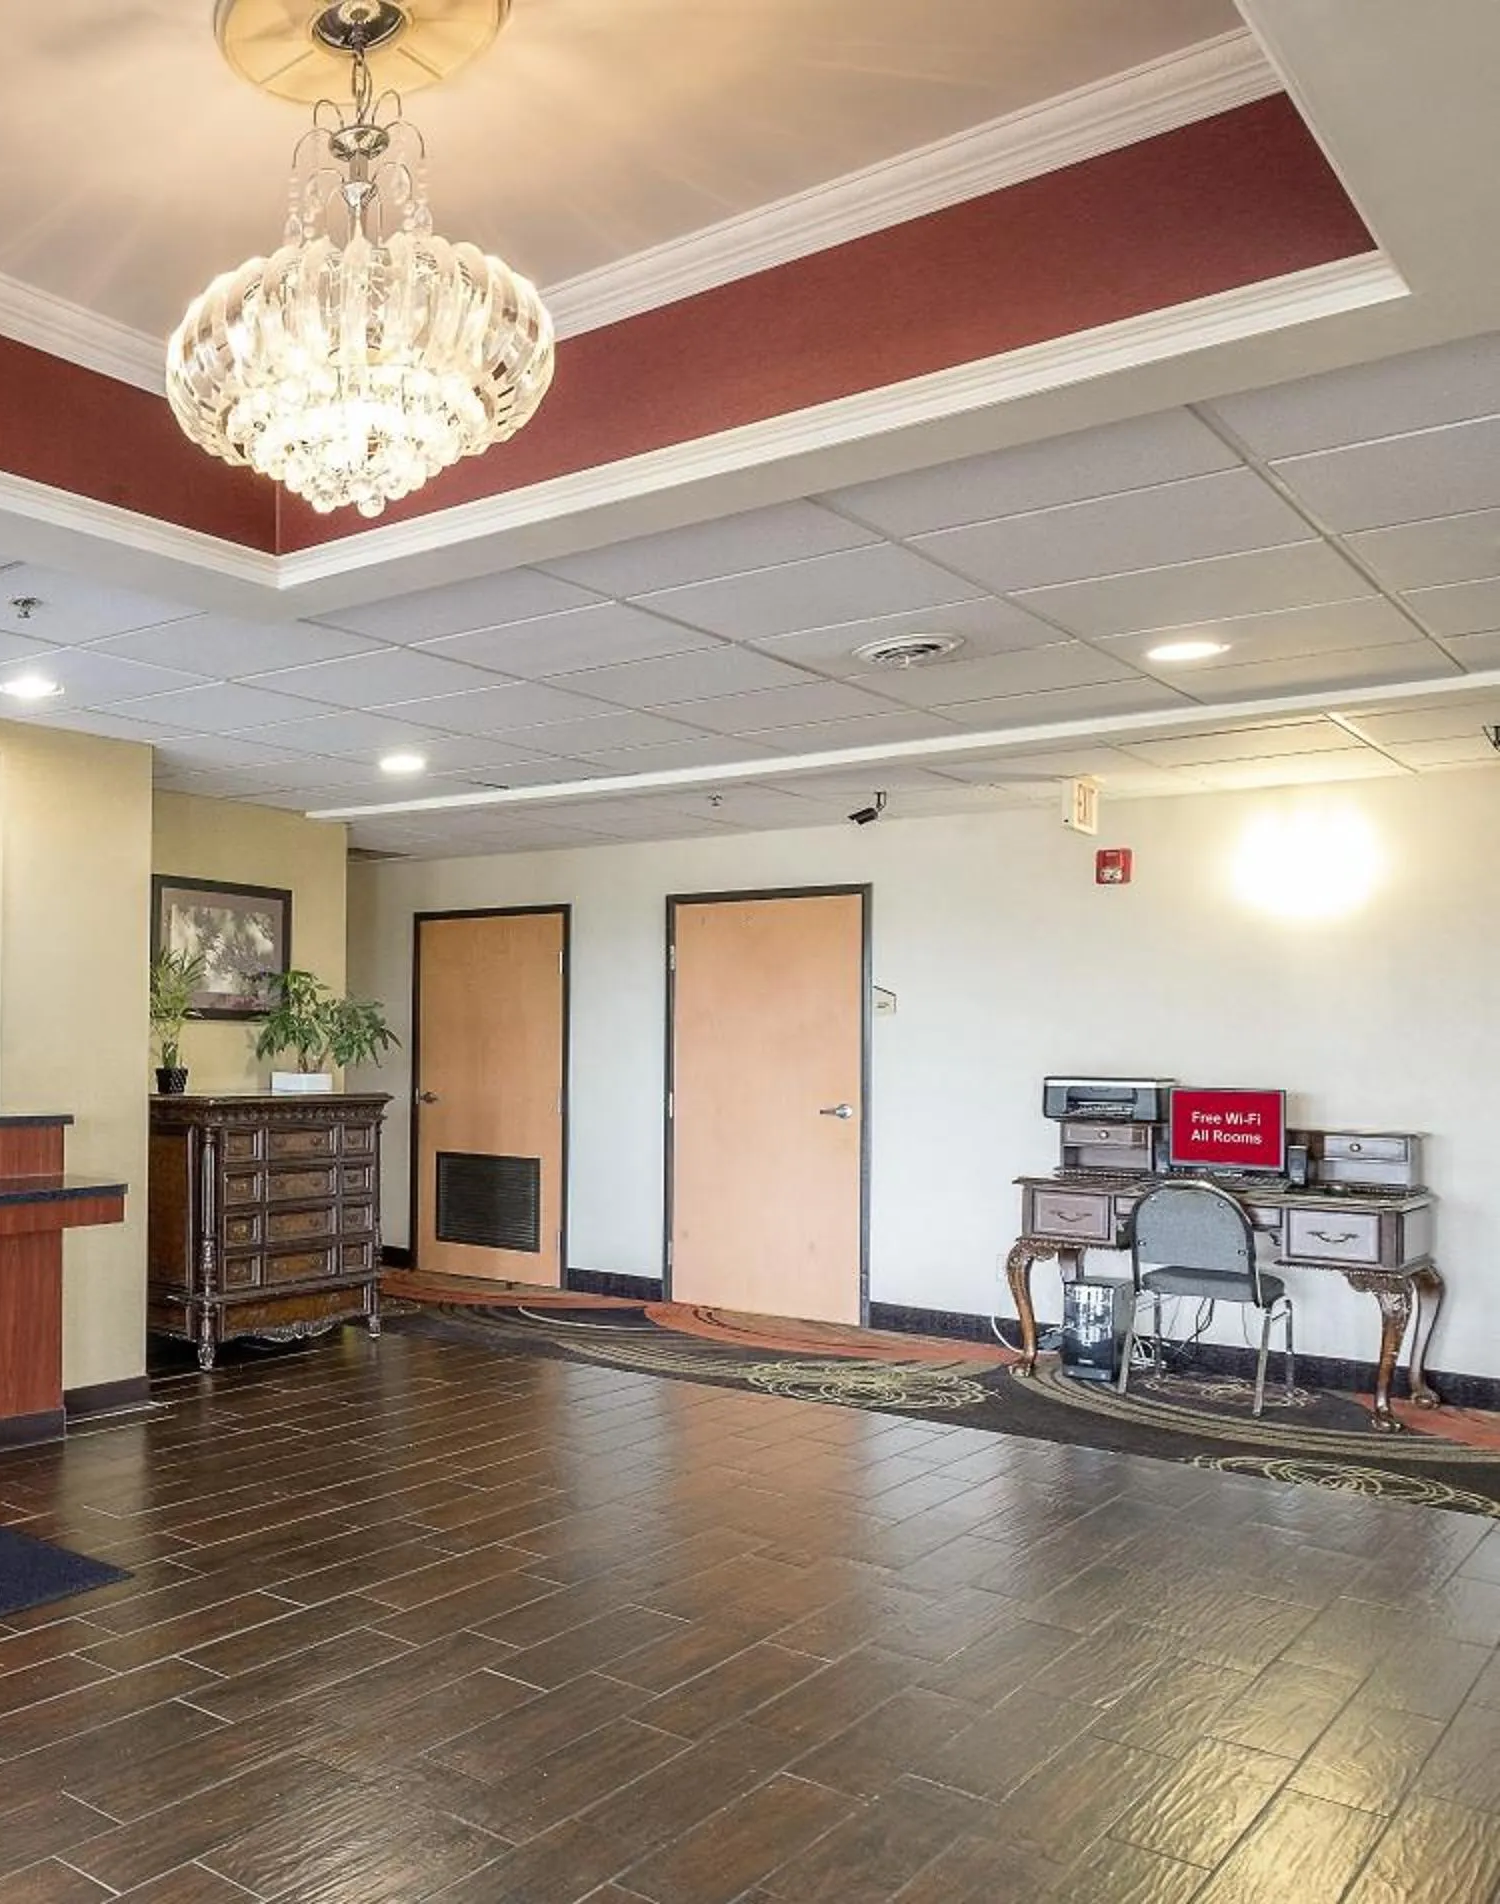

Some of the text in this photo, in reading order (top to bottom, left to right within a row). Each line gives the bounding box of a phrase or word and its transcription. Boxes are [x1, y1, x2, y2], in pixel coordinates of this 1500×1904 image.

[1191, 1111, 1261, 1126] Free Wi-Fi
[1191, 1129, 1262, 1144] All Rooms
